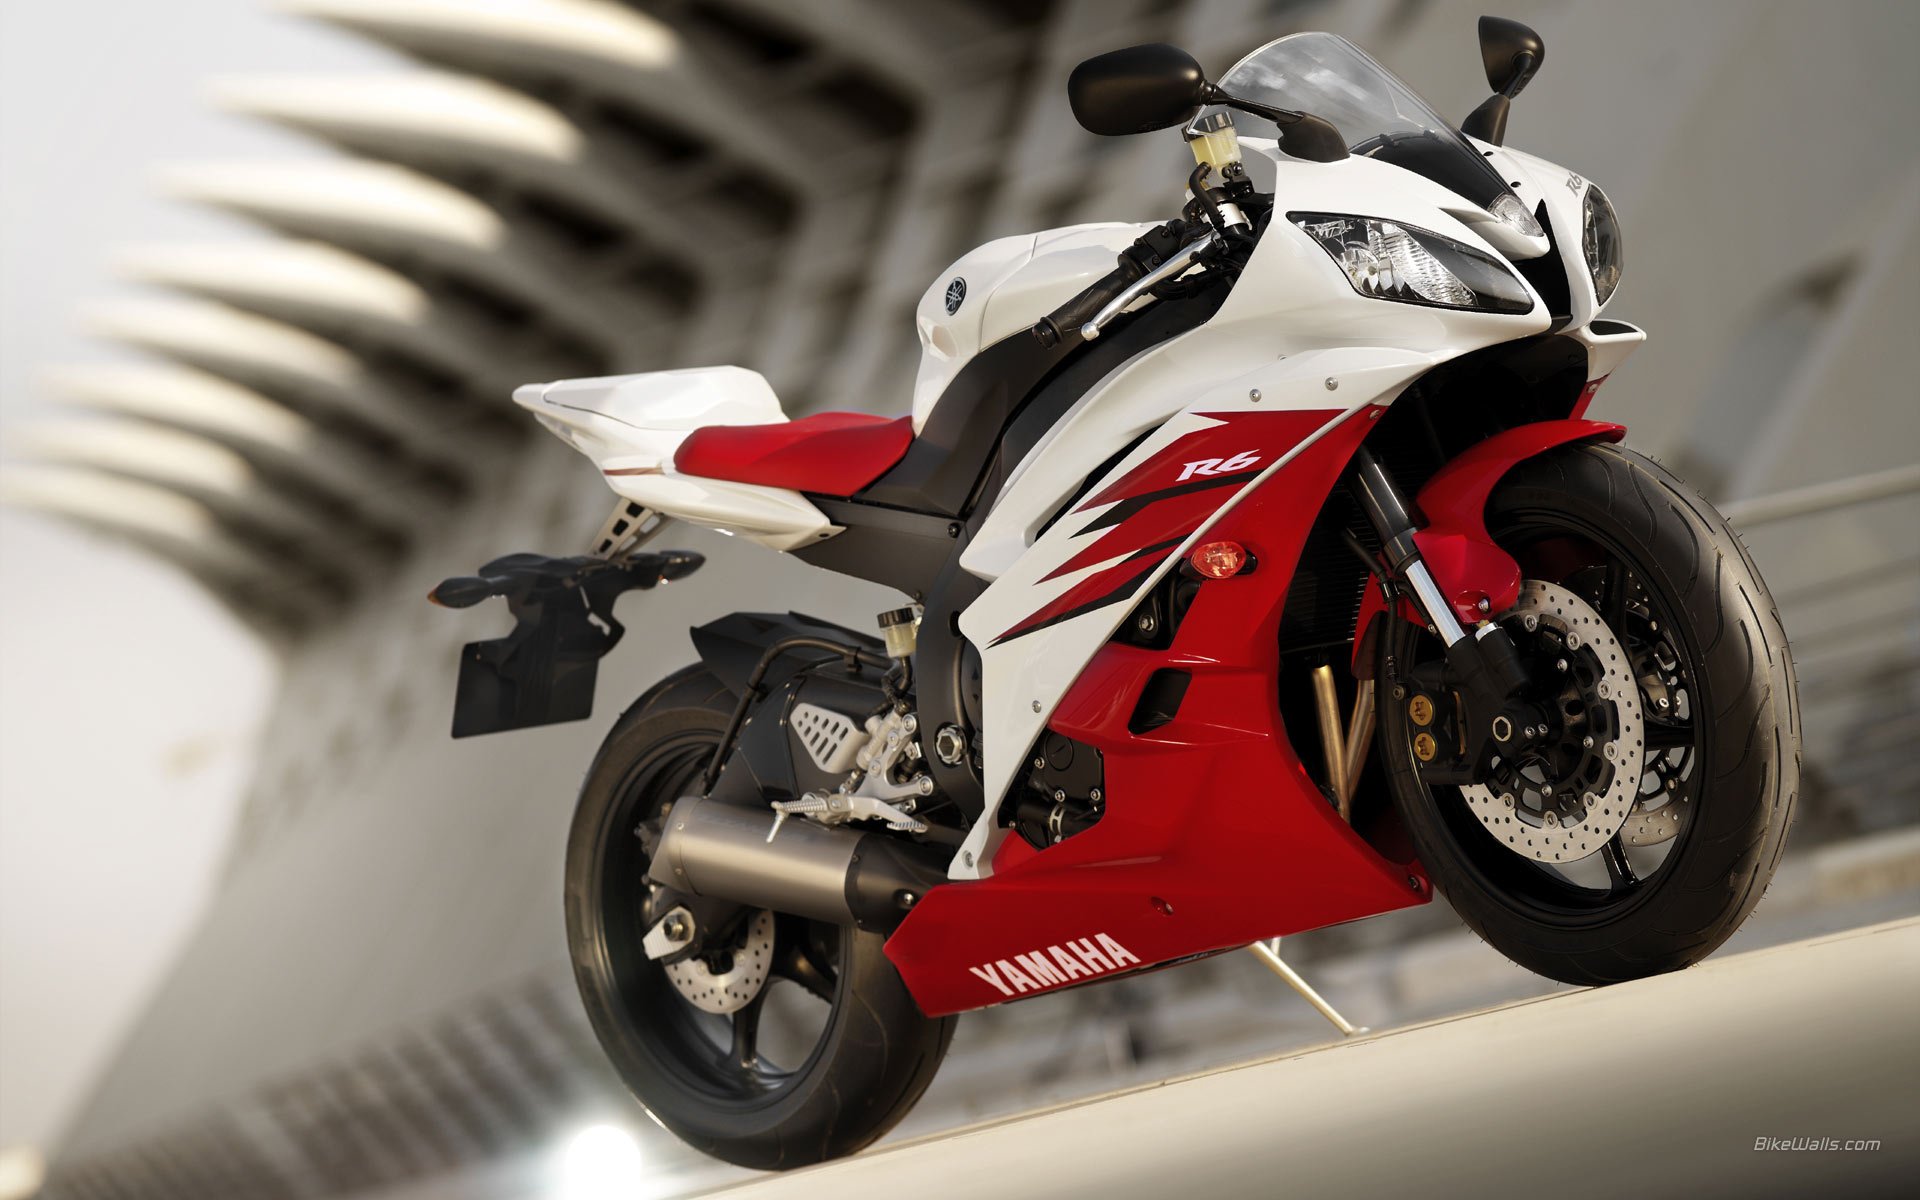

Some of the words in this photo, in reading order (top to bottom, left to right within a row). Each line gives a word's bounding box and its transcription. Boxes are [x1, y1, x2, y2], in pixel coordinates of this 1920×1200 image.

[1565, 172, 1583, 198] R6
[1175, 449, 1262, 482] R6
[968, 932, 1142, 997] YAMAHA
